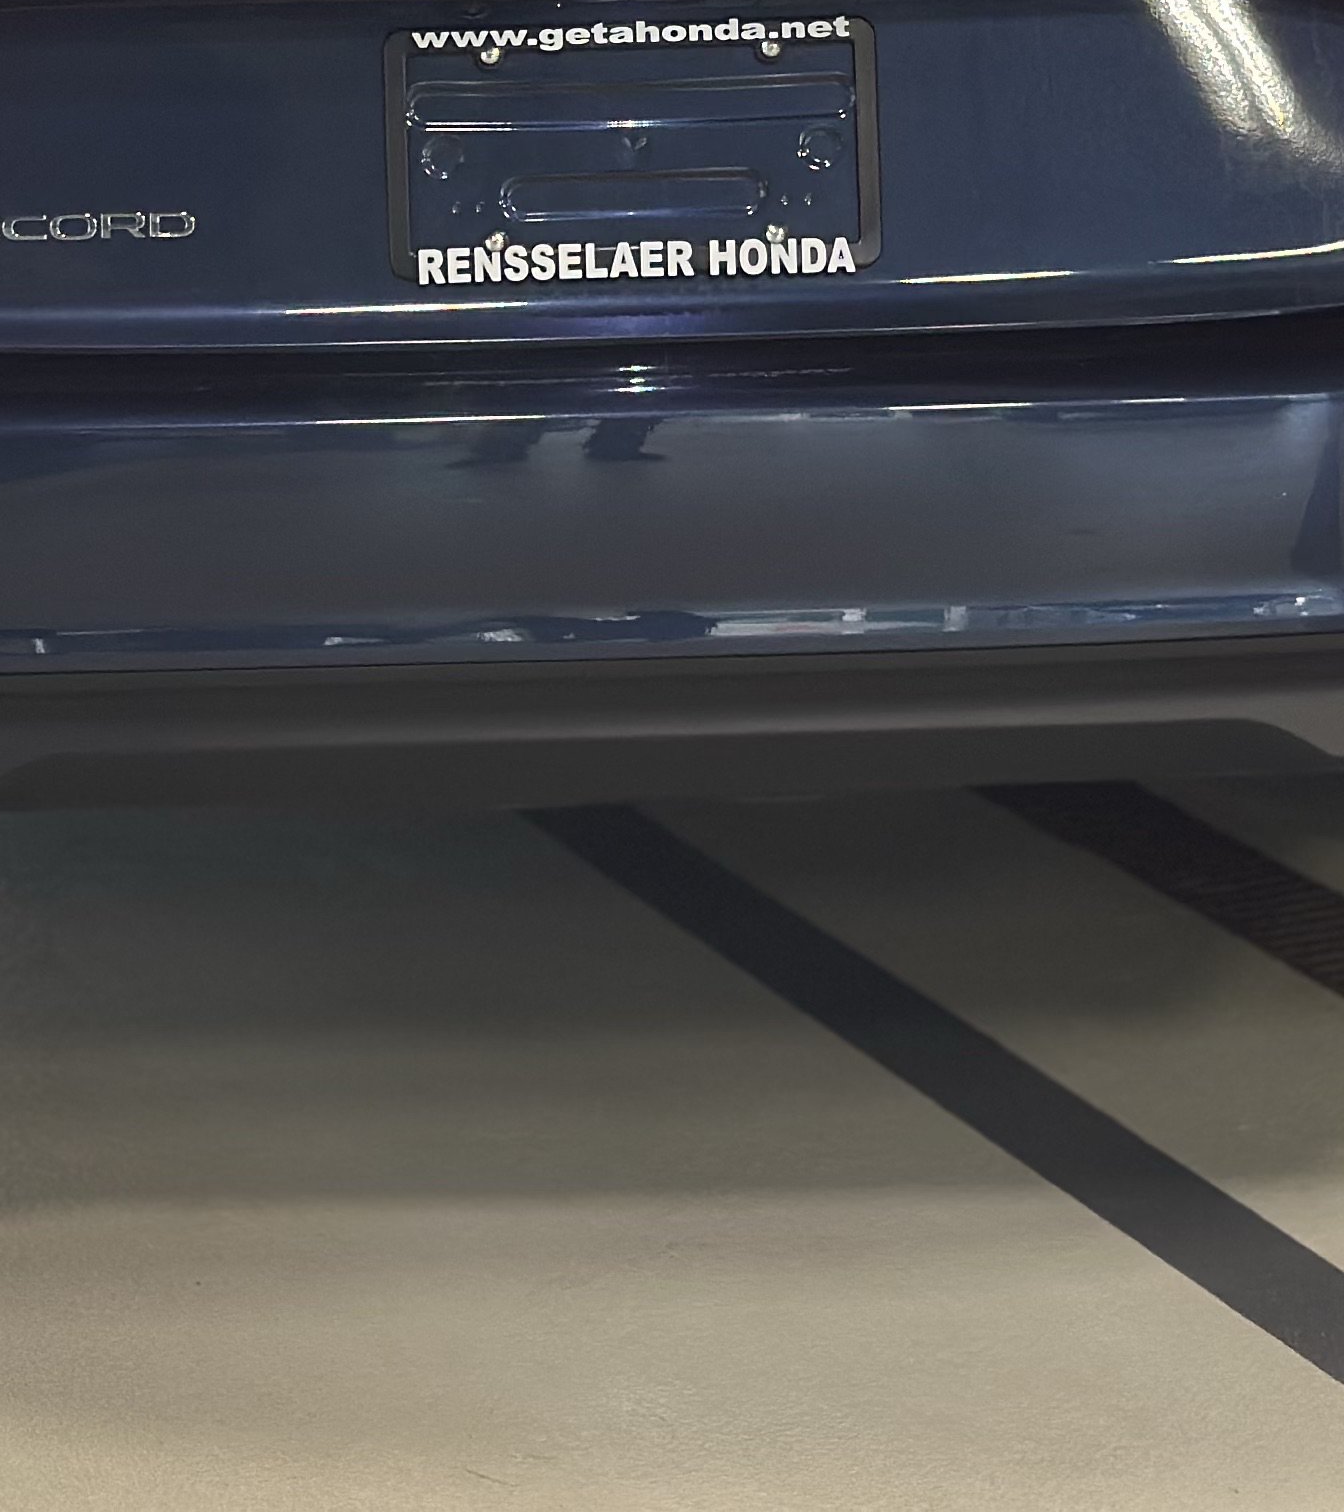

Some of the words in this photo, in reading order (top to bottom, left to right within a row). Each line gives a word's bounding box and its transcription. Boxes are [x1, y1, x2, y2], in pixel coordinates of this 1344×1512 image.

[412, 16, 850, 50] www.getahonda.net
[418, 240, 694, 285] RENSSELAER
[709, 237, 856, 275] HONDA
